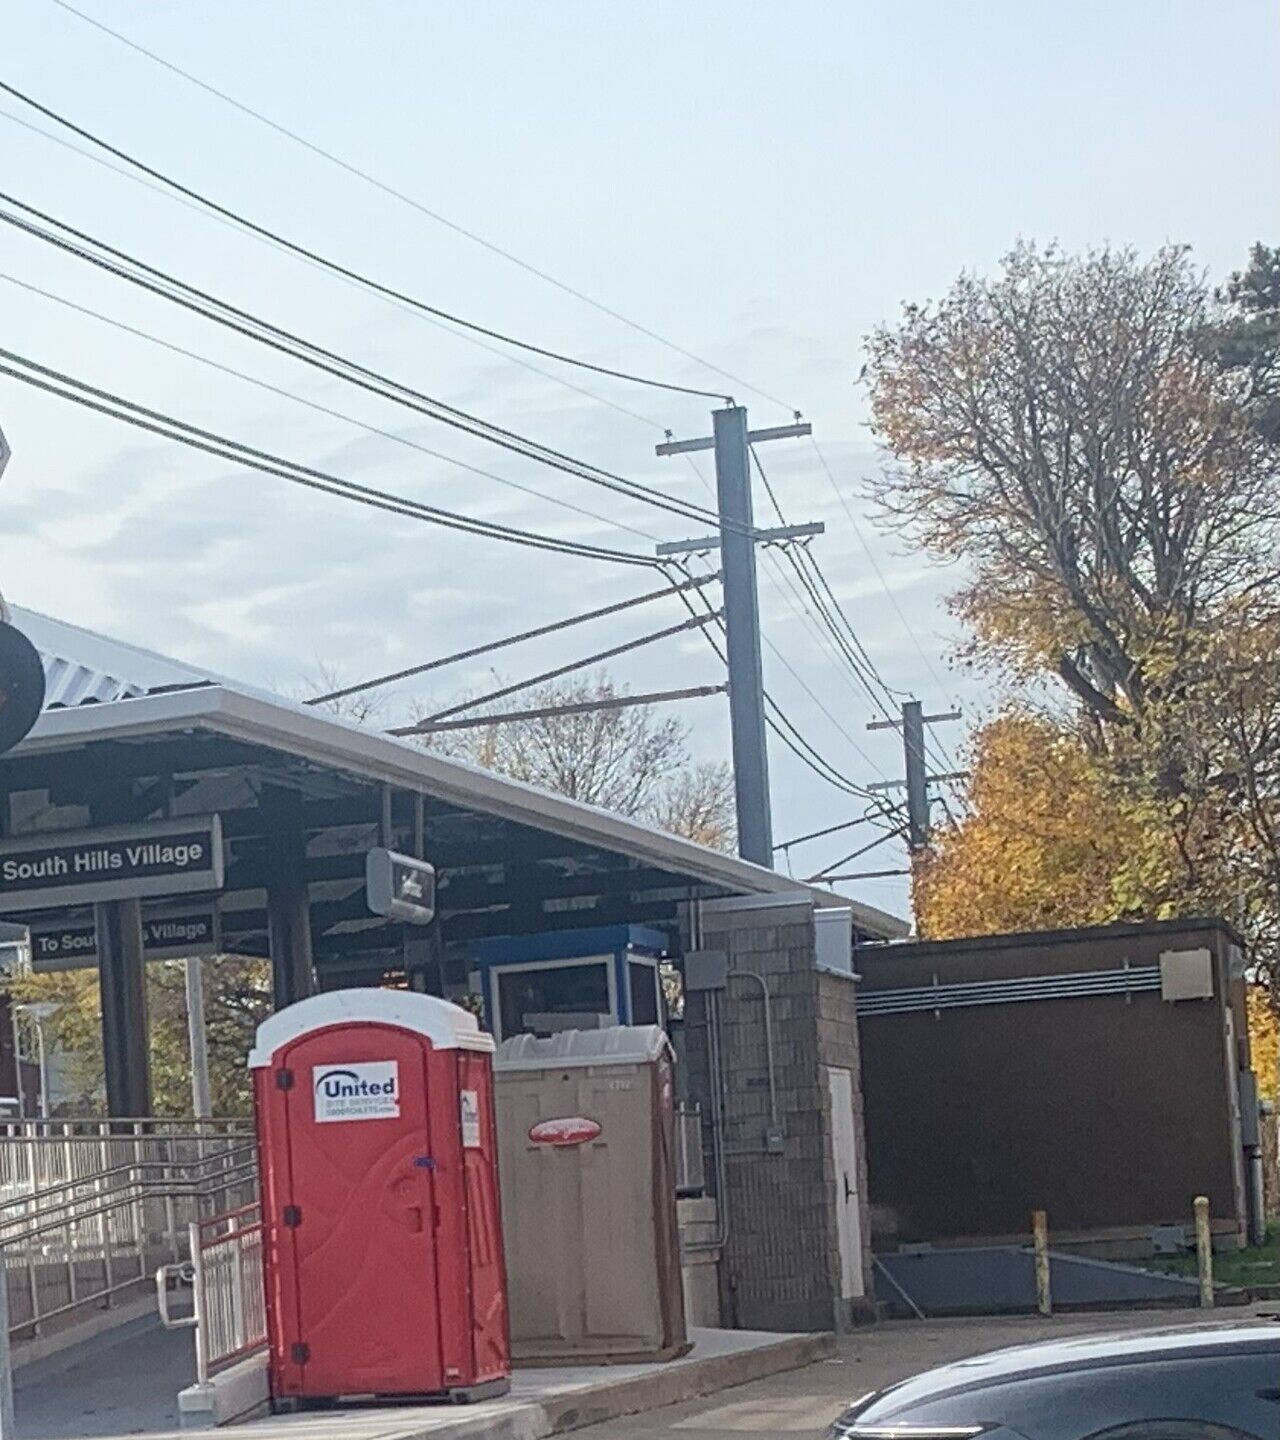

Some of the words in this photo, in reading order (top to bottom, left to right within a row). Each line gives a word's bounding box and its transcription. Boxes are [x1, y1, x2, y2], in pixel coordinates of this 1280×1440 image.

[3, 856, 68, 881] South
[74, 850, 122, 873] Hills
[126, 843, 203, 868] Village
[39, 937, 59, 952] To
[151, 921, 207, 940] Village
[324, 1077, 395, 1098] United
